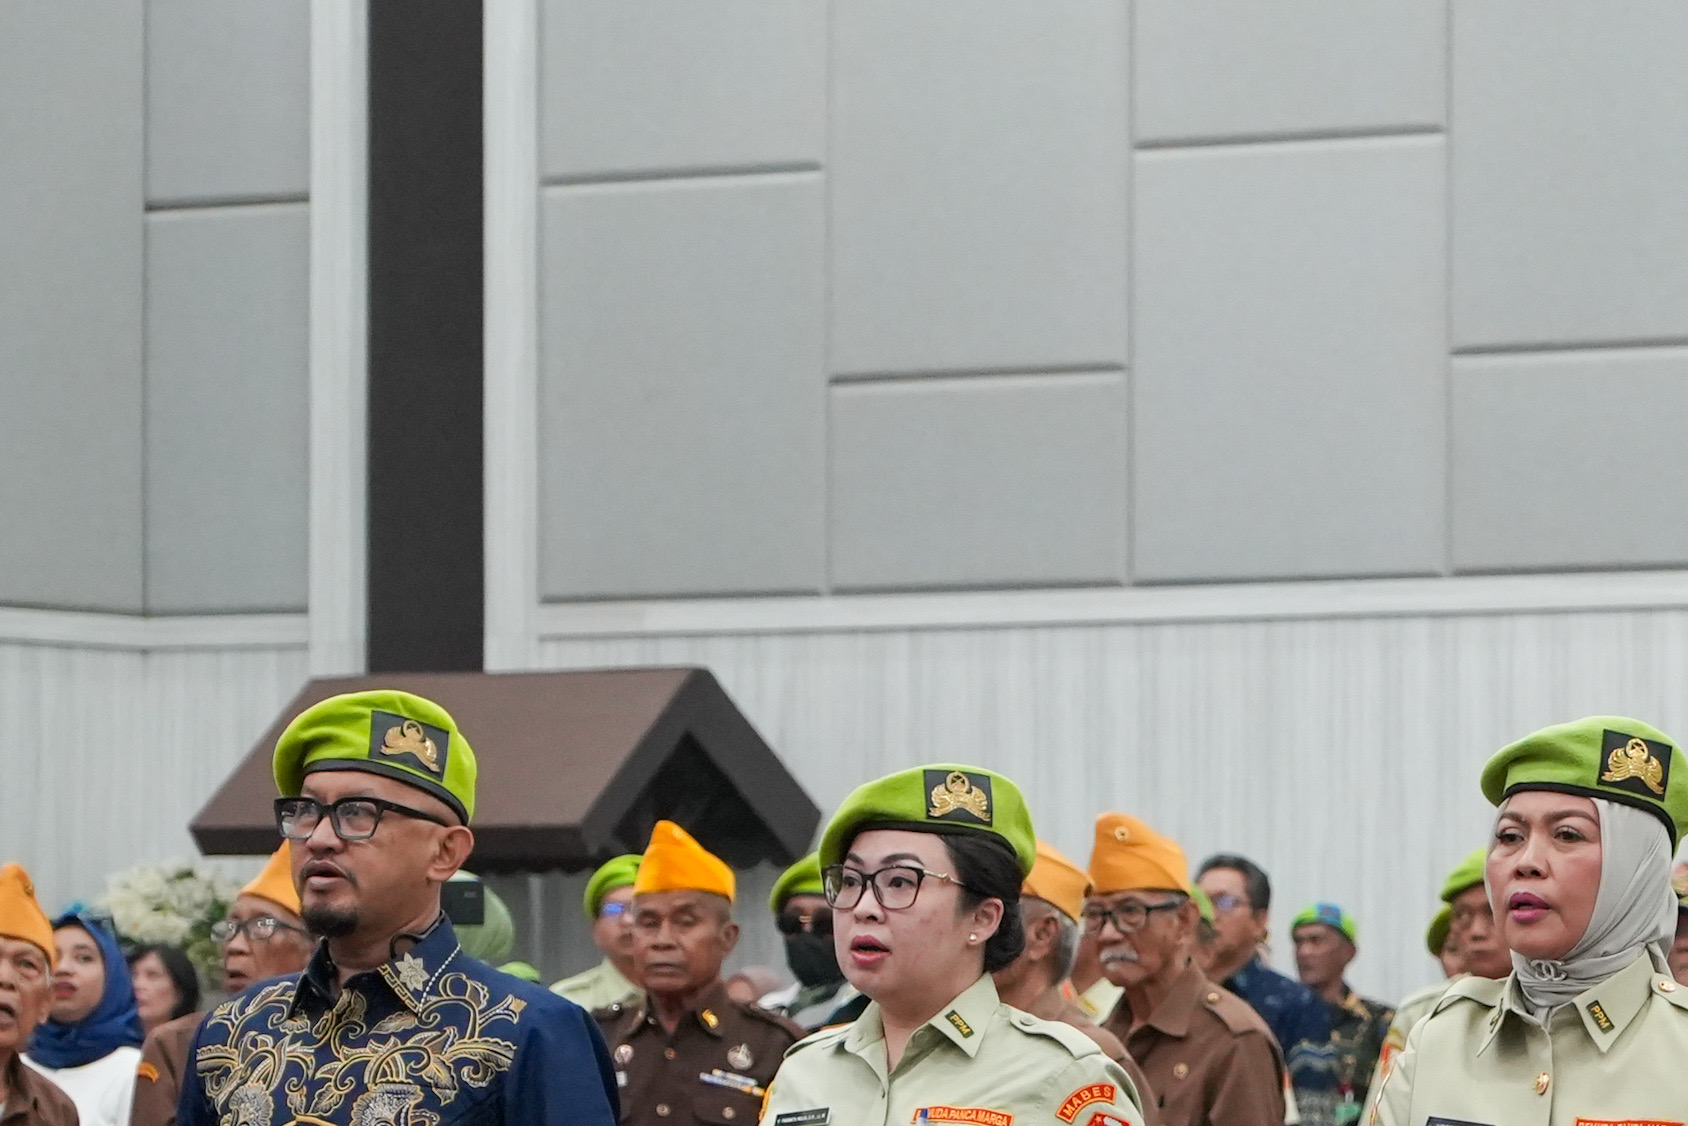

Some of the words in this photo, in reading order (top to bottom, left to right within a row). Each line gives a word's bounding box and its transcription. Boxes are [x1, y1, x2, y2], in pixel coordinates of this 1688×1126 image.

[950, 1013, 971, 1035] PPM
[1590, 1004, 1611, 1029] PPM
[1062, 1085, 1112, 1117] MABES
[915, 1108, 948, 1119] PMUDA
[948, 1109, 977, 1121] PANCA
